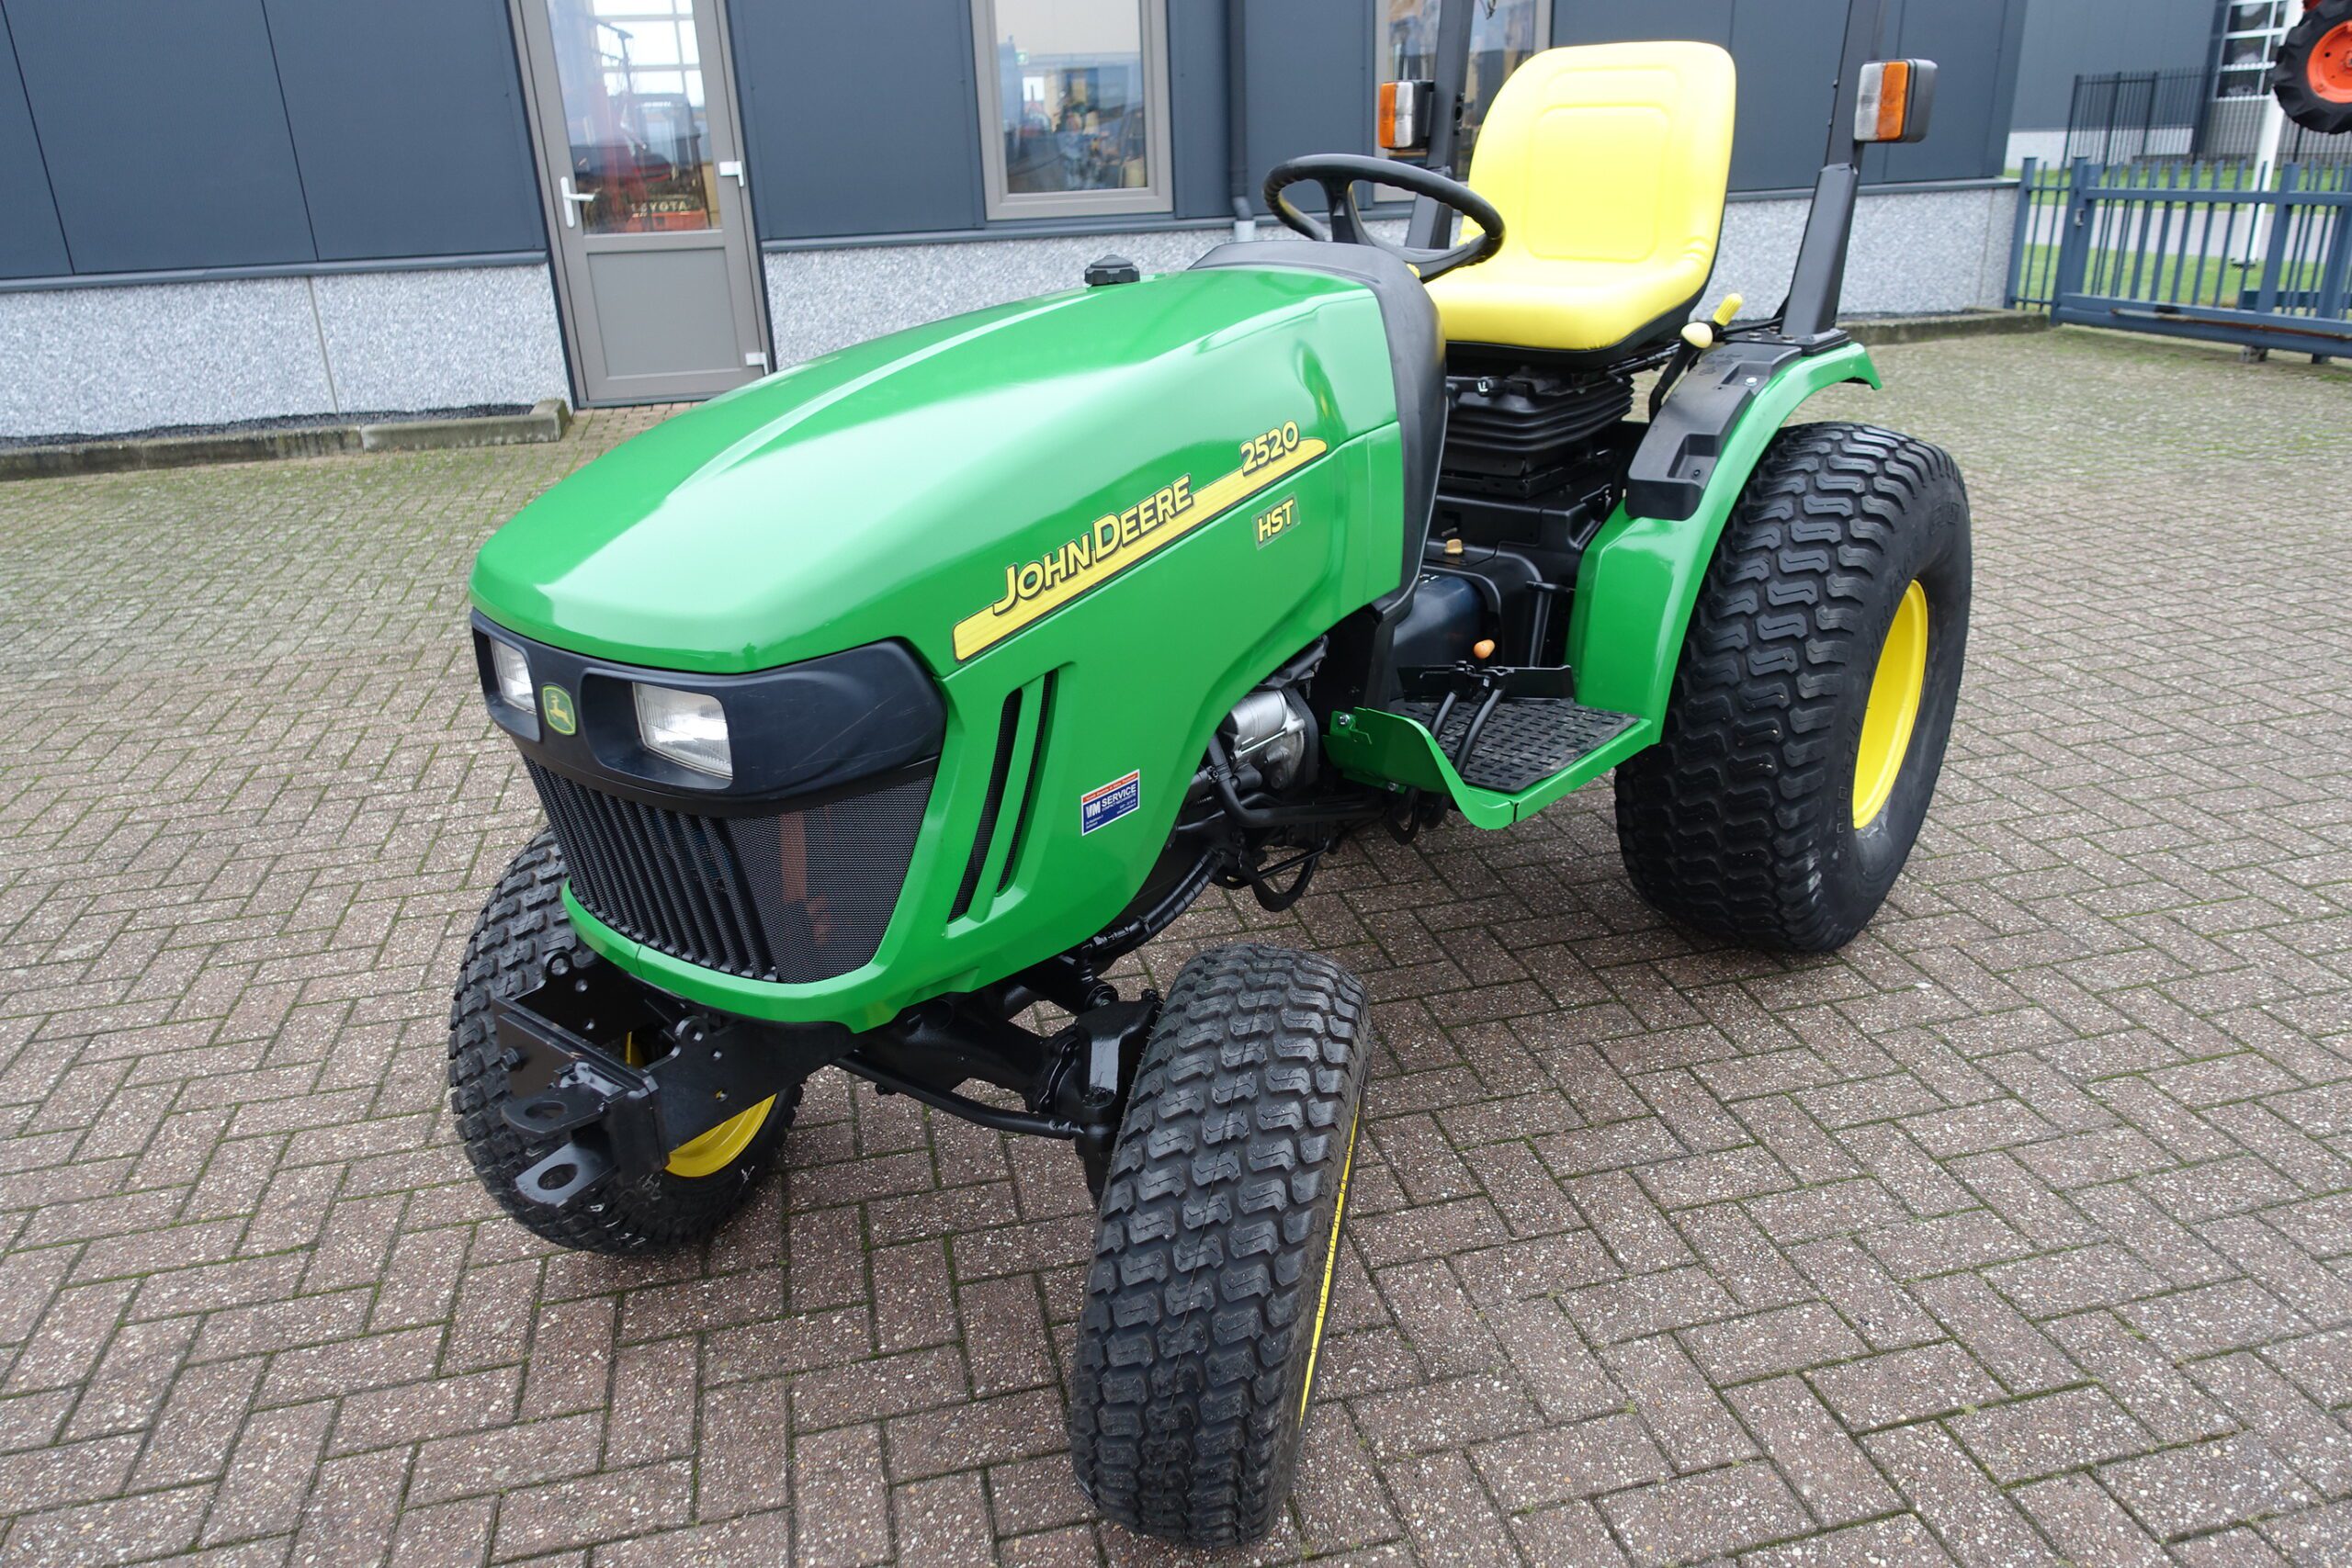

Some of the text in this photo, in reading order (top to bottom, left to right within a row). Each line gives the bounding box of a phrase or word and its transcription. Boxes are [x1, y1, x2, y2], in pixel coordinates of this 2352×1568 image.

[1239, 420, 1300, 477] 2520
[992, 474, 1193, 615] JOHN DEERE
[1257, 497, 1295, 544] HST
[1102, 784, 1136, 807] SERVICE
